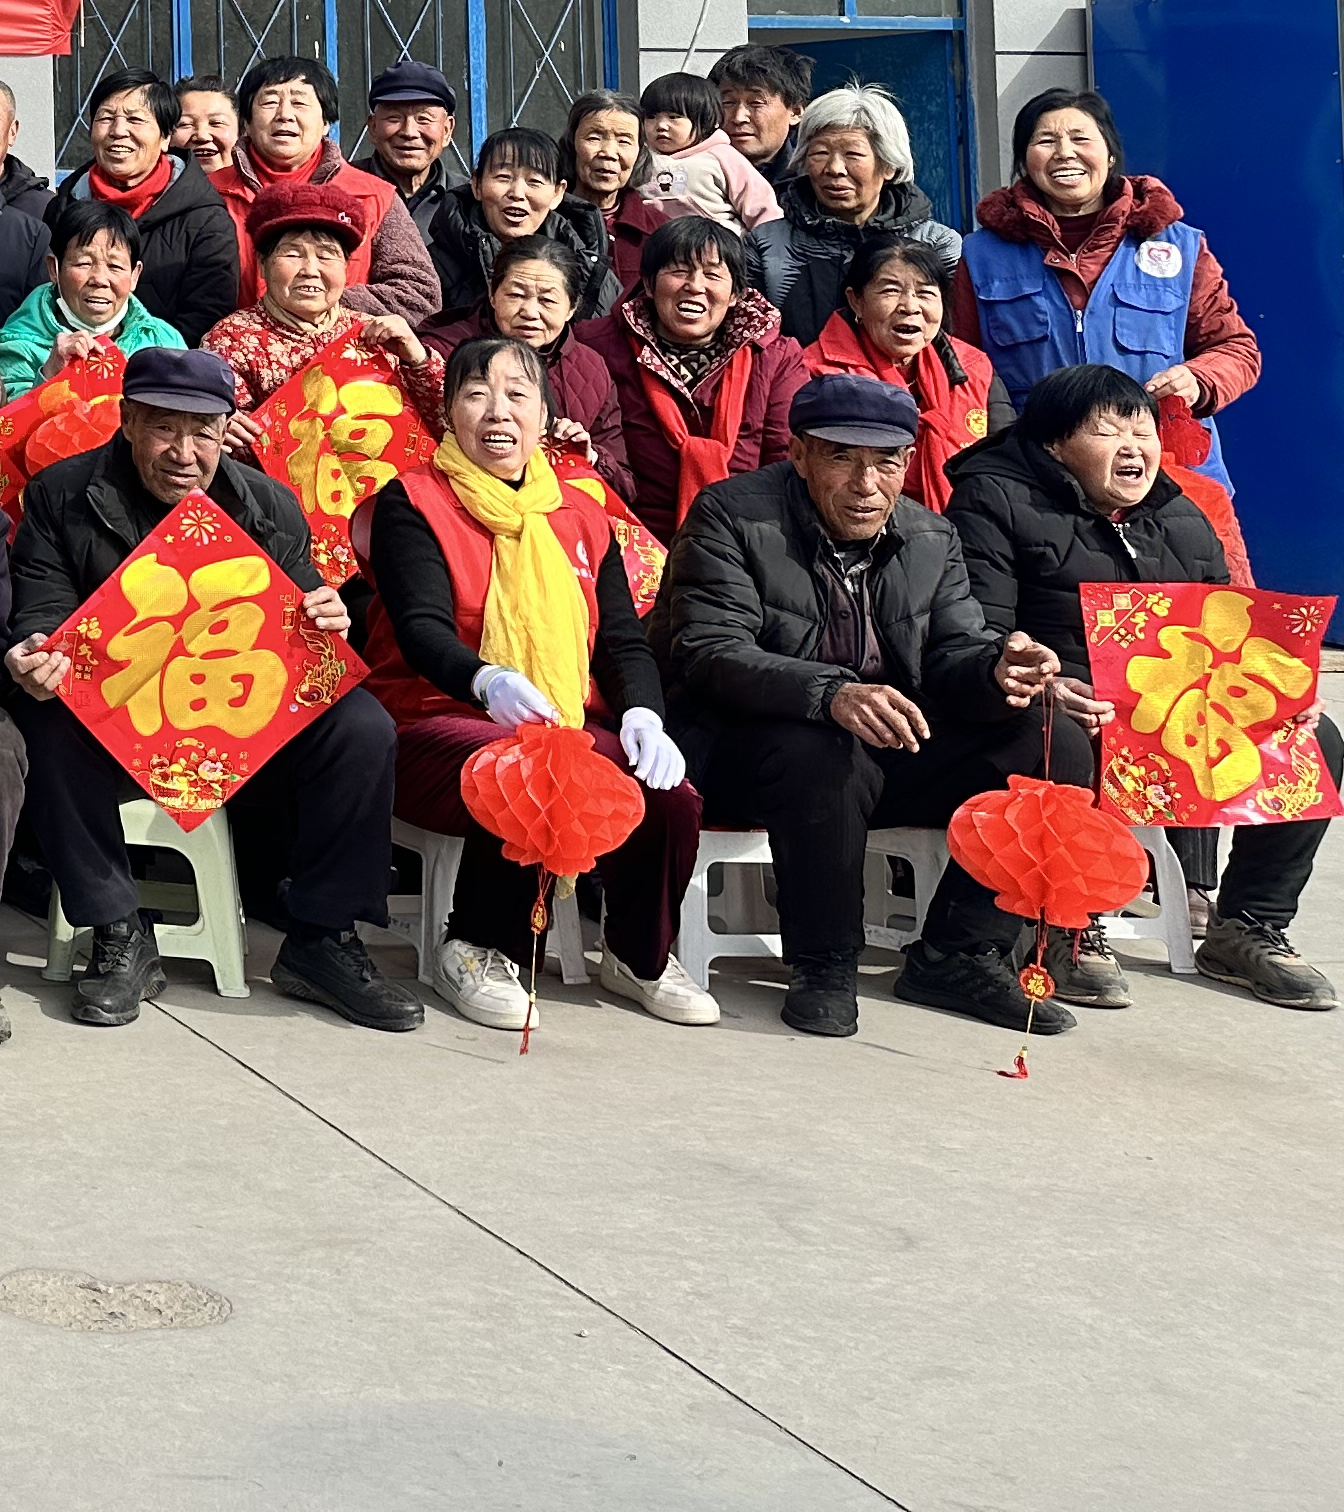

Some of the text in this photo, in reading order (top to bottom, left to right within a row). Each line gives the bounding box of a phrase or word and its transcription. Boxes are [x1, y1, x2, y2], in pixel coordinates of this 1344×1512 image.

[287, 363, 404, 520] 福
[101, 554, 289, 739] 福
[1126, 590, 1312, 803] 福
